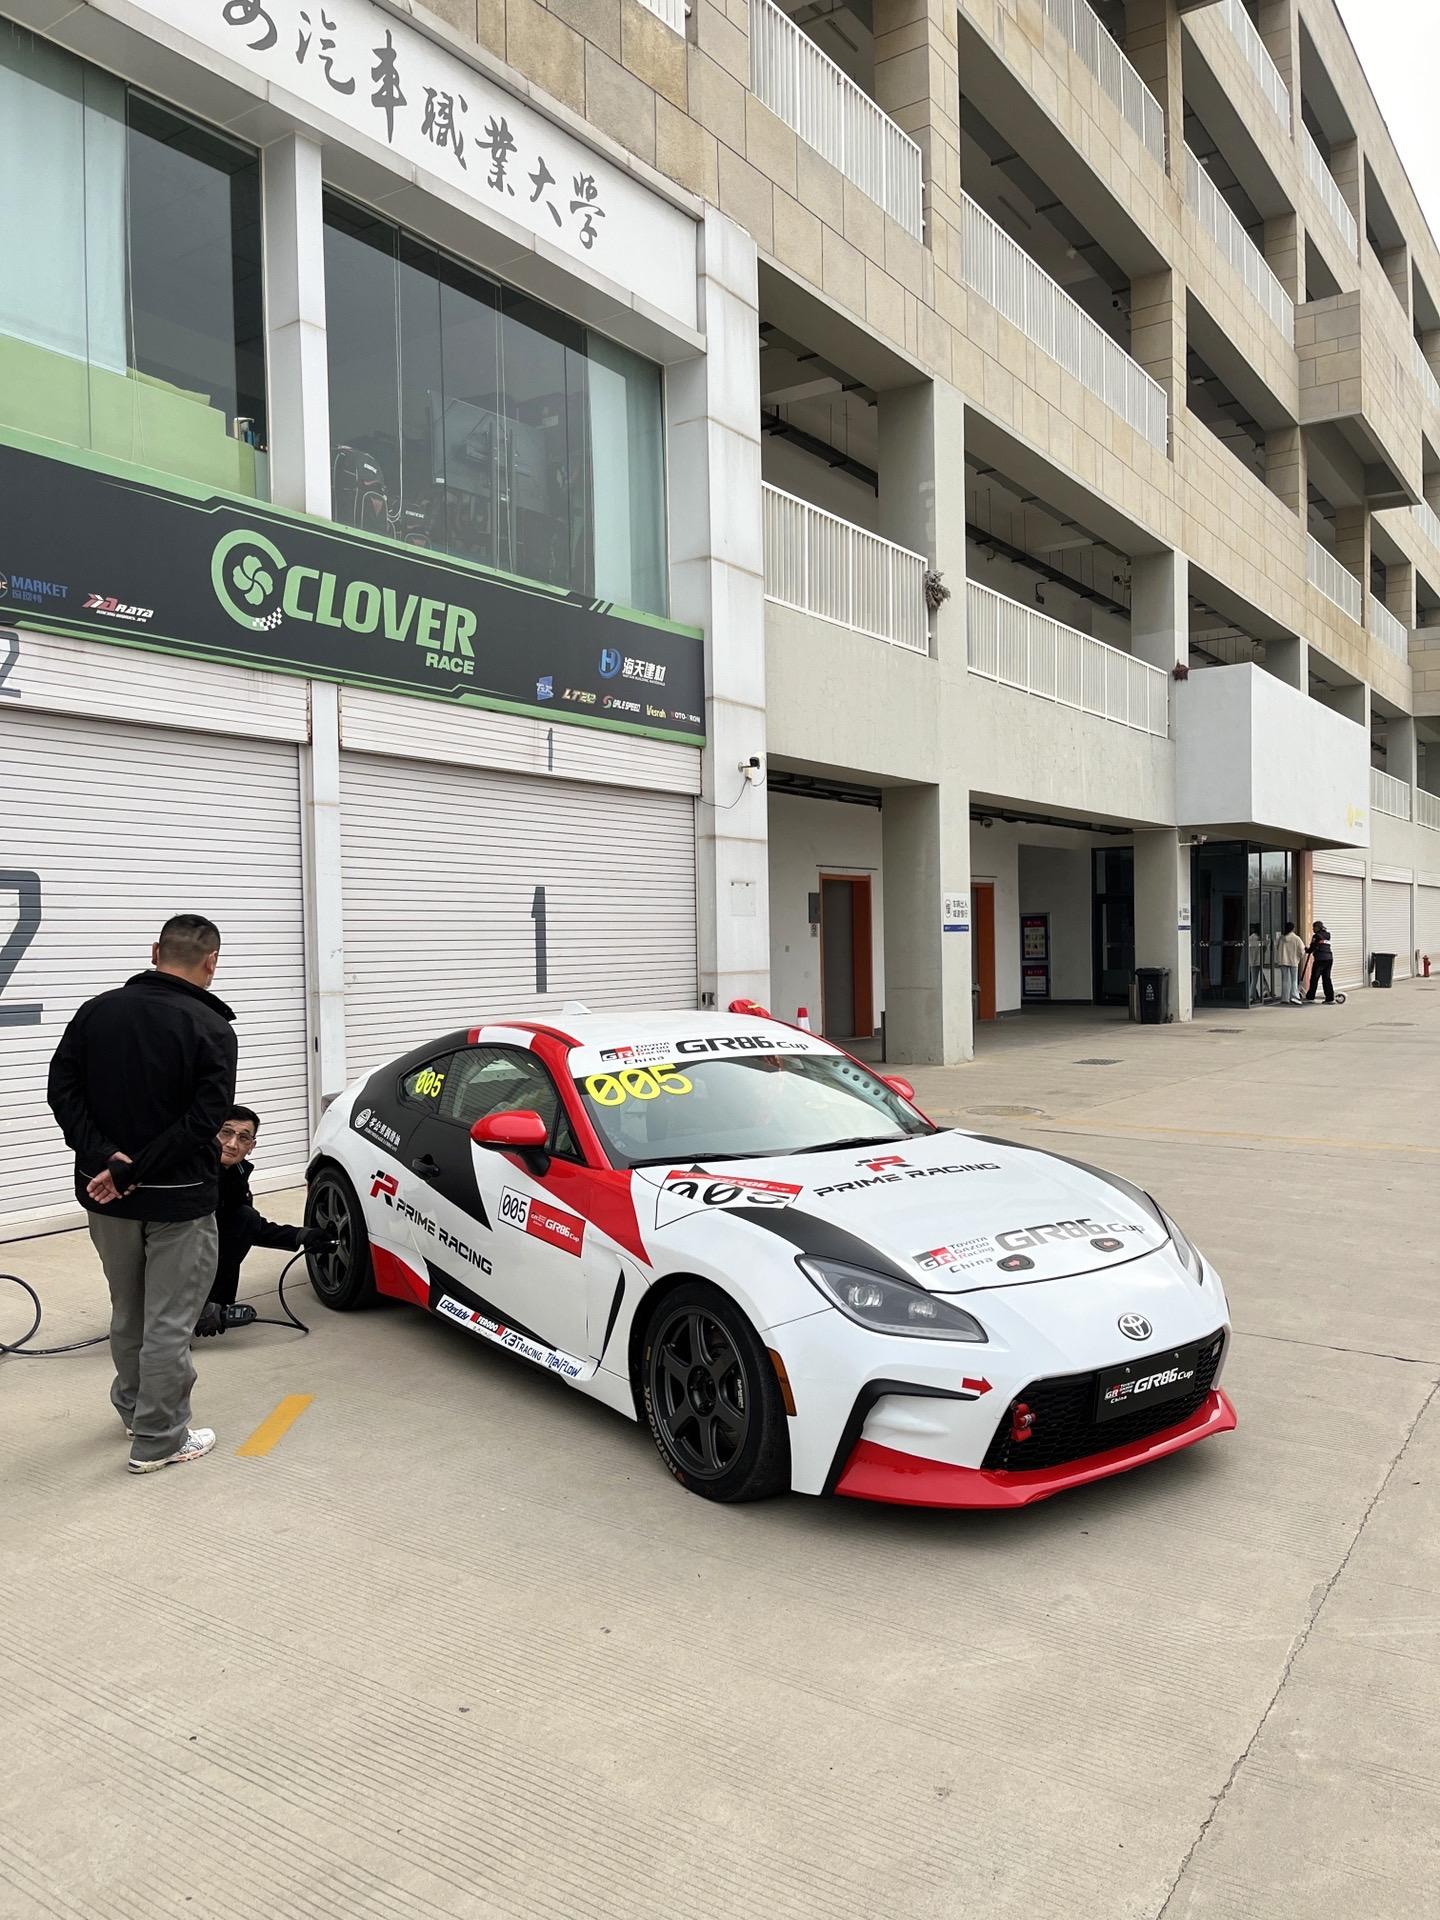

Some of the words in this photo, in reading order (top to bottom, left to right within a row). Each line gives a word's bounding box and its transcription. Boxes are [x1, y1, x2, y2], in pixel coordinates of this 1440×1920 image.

[11, 576, 68, 598] MARKET
[283, 565, 477, 657] CLOVER
[425, 652, 475, 675] RACE
[622, 657, 667, 682] 海天建材
[646, 704, 667, 719] Vesrah
[548, 727, 553, 772] 1
[0, 870, 43, 1026] 2
[531, 887, 547, 993] 1
[675, 1036, 775, 1054] GR86
[776, 1041, 810, 1050] Cup
[624, 1056, 665, 1064] China
[415, 1070, 445, 1098] 005
[585, 1063, 693, 1106] 005
[813, 1173, 903, 1197] PRIME
[908, 1162, 1002, 1179] RACING
[502, 1194, 528, 1223] 005
[395, 1198, 436, 1235] PRIME
[438, 1227, 493, 1276] RACING
[545, 1219, 571, 1237] GR86
[994, 1218, 1109, 1251] GR86
[1106, 1222, 1147, 1234] Cup
[949, 1256, 994, 1274] China
[957, 1246, 996, 1260] Racing
[440, 1299, 470, 1321] GReddy
[476, 1314, 499, 1332] FERODO
[519, 1342, 543, 1361] RACING
[1133, 1367, 1179, 1394] GR86
[1178, 1370, 1194, 1380] Cup
